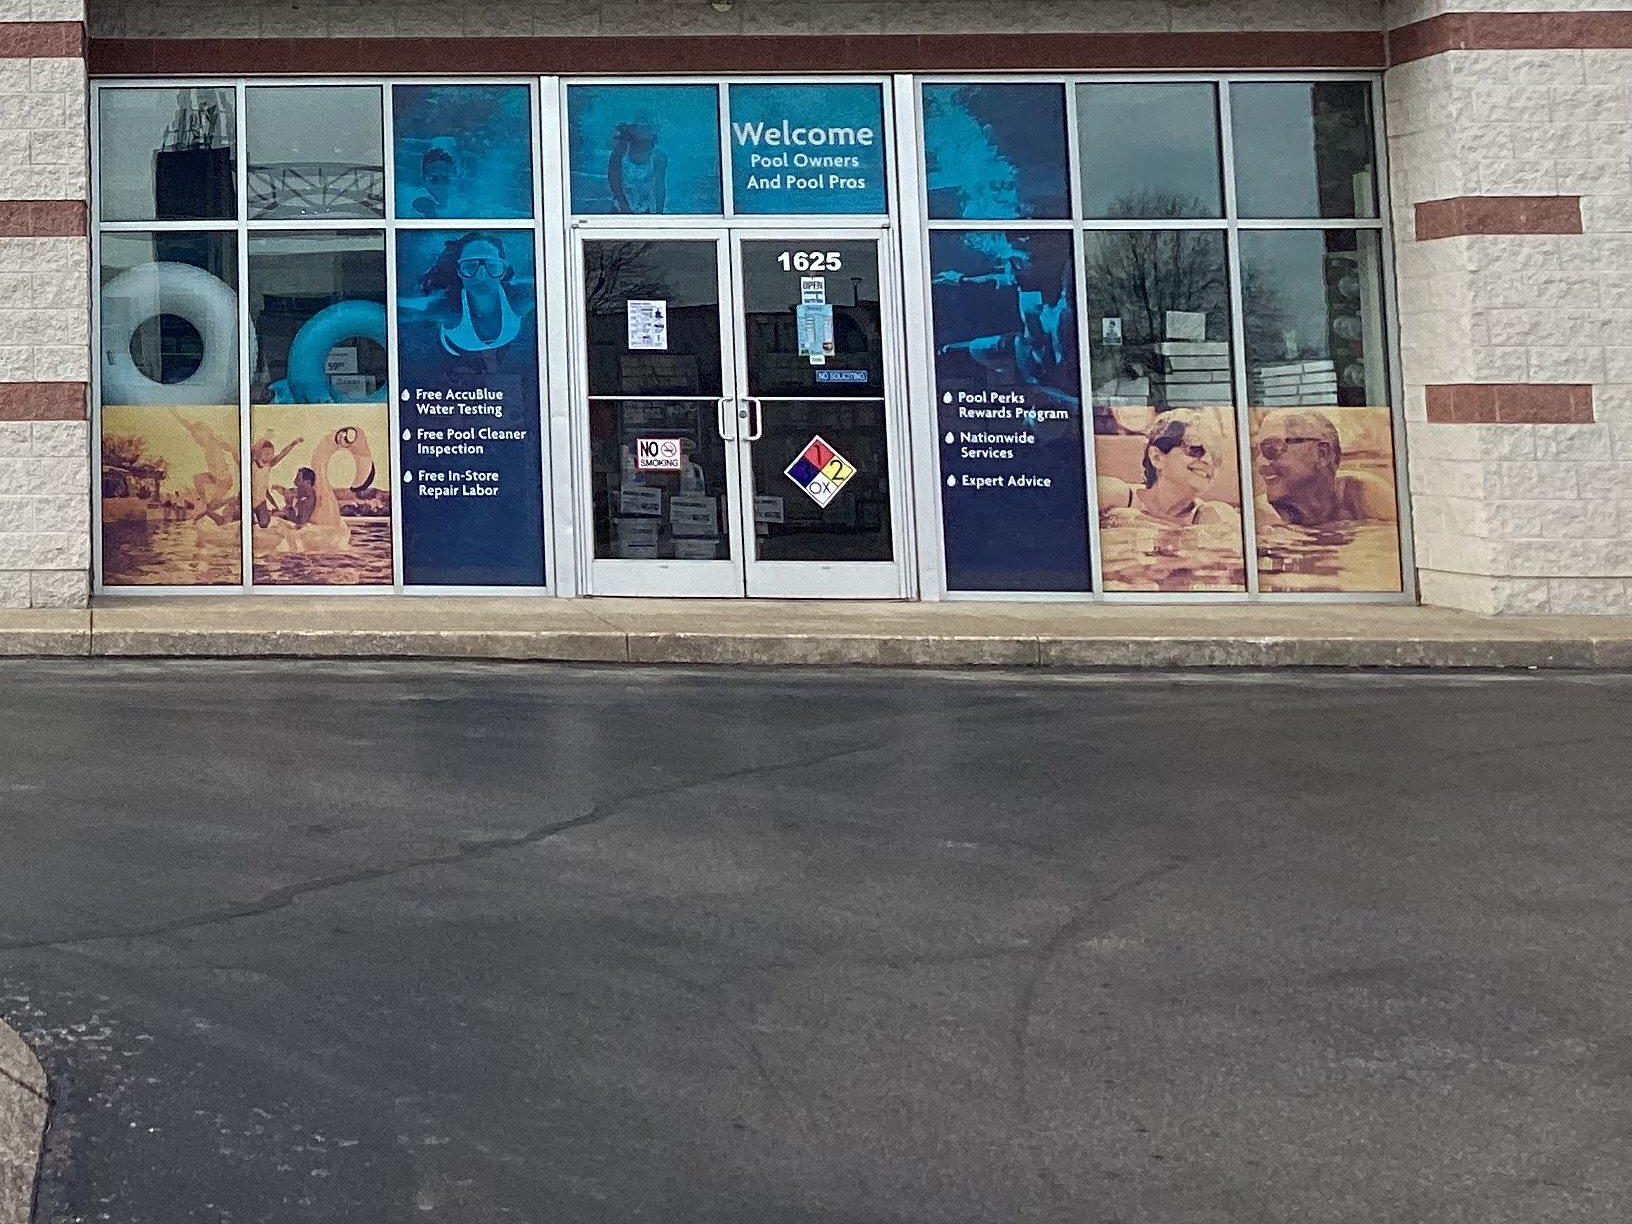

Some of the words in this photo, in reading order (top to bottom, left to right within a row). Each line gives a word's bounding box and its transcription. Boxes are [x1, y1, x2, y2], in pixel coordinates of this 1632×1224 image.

[732, 119, 874, 146] Welcome
[751, 152, 789, 167] Pool
[793, 153, 859, 167] Owners
[746, 174, 781, 189] And
[786, 174, 824, 189] Pool
[829, 174, 866, 189] Pros
[777, 251, 842, 271] 1625
[416, 388, 442, 400] Free
[445, 388, 503, 400] AccuBlue
[958, 391, 987, 403] Pool
[990, 391, 1025, 404] Perks
[416, 403, 454, 415] Water
[457, 403, 503, 418] Testing
[959, 406, 1012, 418] Rewards
[1015, 407, 1069, 422] Program
[417, 428, 444, 440] Free
[447, 427, 475, 440] Pool
[478, 427, 527, 440] Cleaner
[960, 431, 1035, 444] Nationwide
[417, 443, 484, 457] Inspection
[640, 441, 659, 457] NO
[814, 444, 822, 466] 1
[961, 447, 1014, 459] Services
[640, 459, 679, 467] SMOKING
[830, 459, 845, 481] 2
[418, 470, 445, 482] Free
[448, 470, 499, 482] In-Store
[962, 475, 1005, 489] Expert
[1007, 474, 1052, 487] Advice
[419, 484, 459, 500] Repair
[462, 484, 499, 496] Labor
[809, 481, 831, 495] OX
